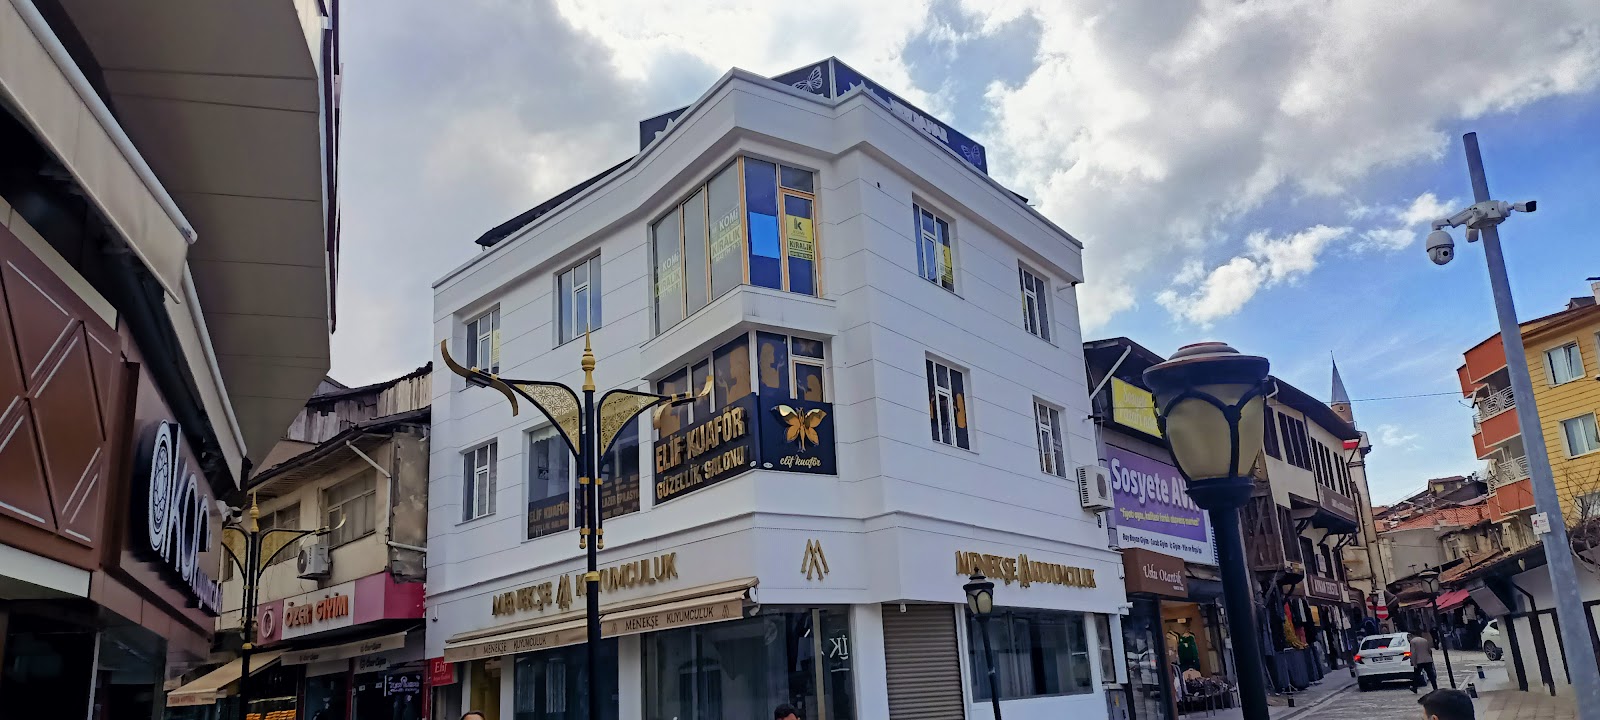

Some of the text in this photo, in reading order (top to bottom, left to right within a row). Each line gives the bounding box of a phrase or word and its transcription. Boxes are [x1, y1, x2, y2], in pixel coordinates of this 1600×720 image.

[789, 240, 813, 252] KIRALIK
[656, 406, 746, 474] ELİF KUAFÖR
[656, 445, 745, 500] GÜZELLİK SALONU
[780, 455, 794, 468] elif
[794, 454, 821, 469] kuaför
[1111, 457, 1169, 504] Sosyete
[491, 580, 553, 616] MENEKŞE
[575, 552, 679, 597] KYUMCULUK
[955, 551, 1016, 586] MENEKŞE
[1159, 569, 1184, 586] Otantik
[284, 601, 313, 628] ÖZER
[315, 591, 349, 622] GİYİM
[625, 606, 714, 632] MENEKŞE KUYUMCULUK
[483, 635, 547, 655] MENEKŞE KUYUMCULUK
